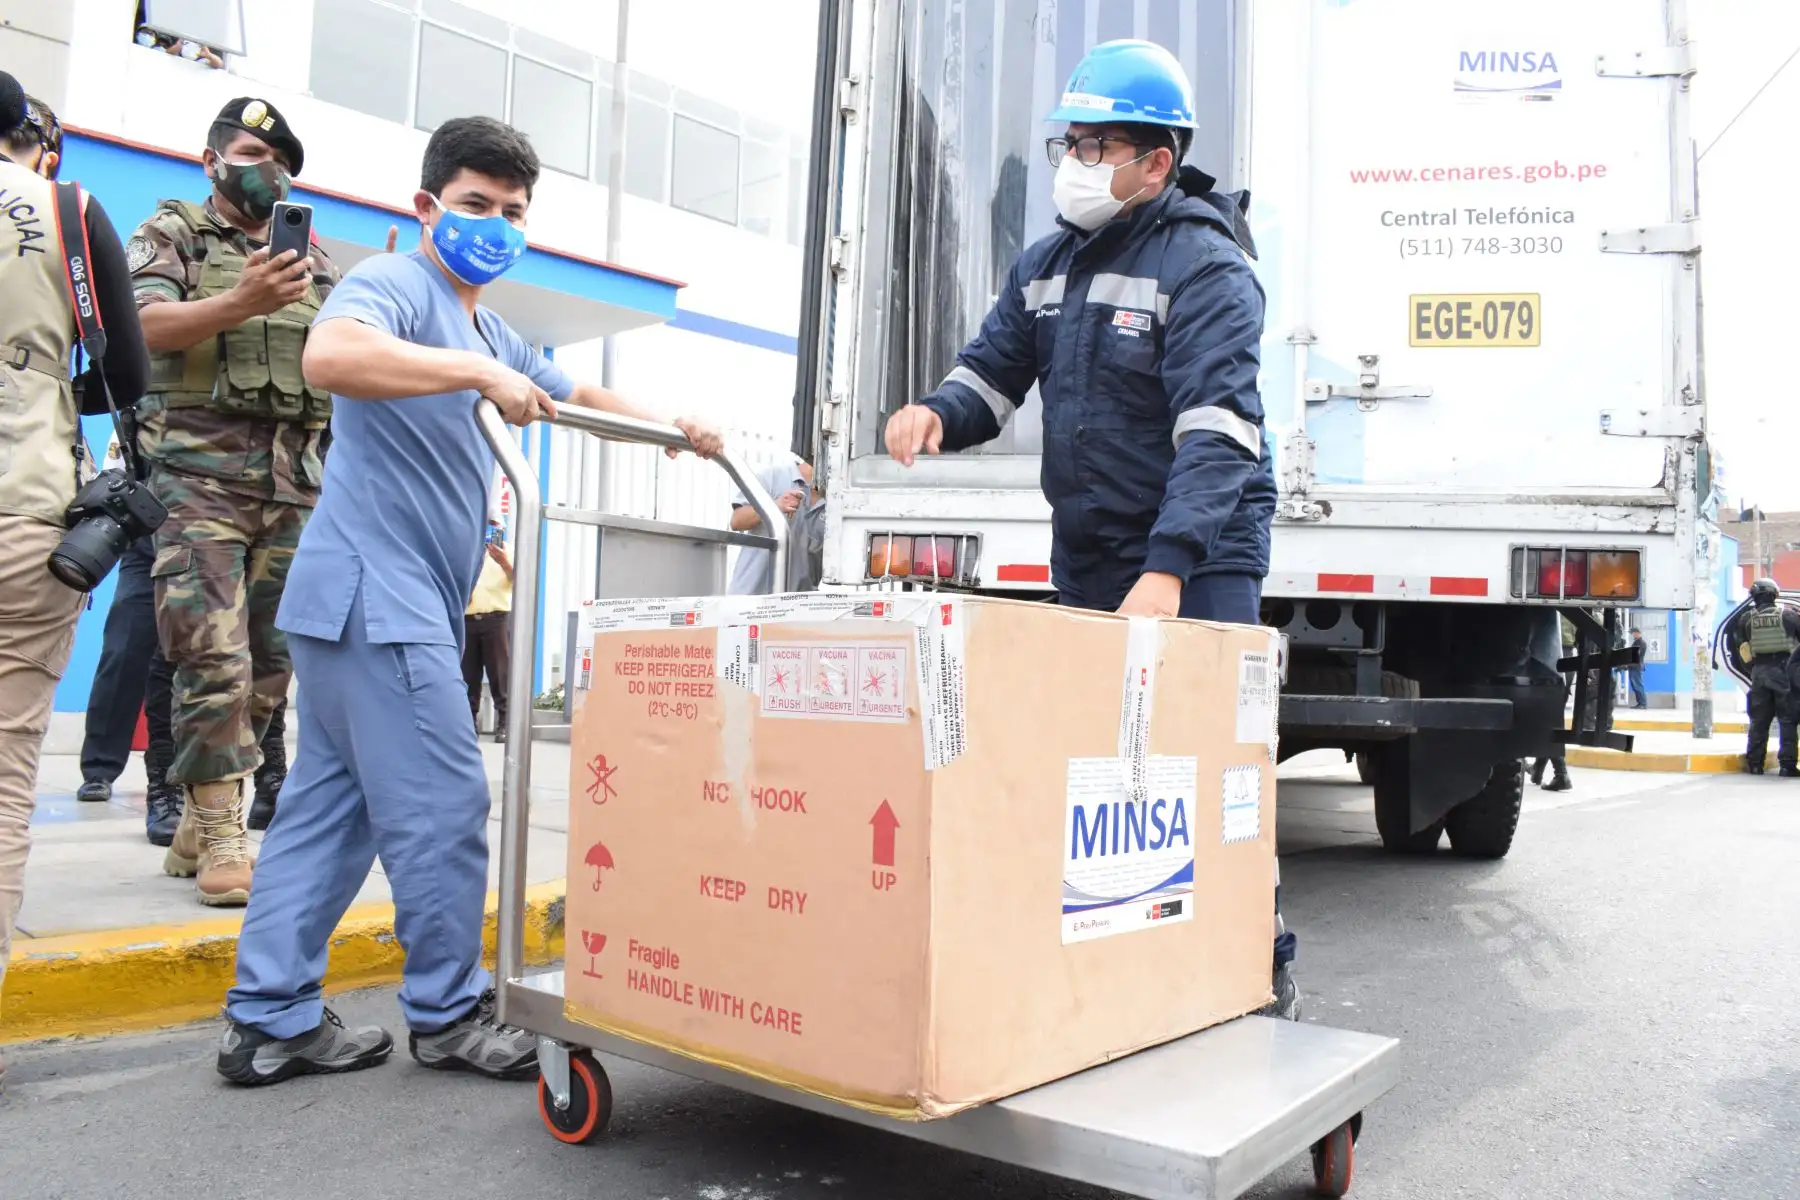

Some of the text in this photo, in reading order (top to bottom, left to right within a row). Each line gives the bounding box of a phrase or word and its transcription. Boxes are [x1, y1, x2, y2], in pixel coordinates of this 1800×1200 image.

[1459, 50, 1559, 73] MINSA
[1350, 160, 1607, 183] www.cenares.gob.pe
[1380, 206, 1575, 227] Central Telefónica
[1398, 236, 1563, 258] (511) 748-3030
[75, 282, 92, 318] EOS
[1415, 300, 1534, 340] EGE-079
[625, 643, 714, 659] Perishable Mate
[772, 650, 802, 660] VACCINE
[818, 650, 848, 660] VACUNA
[615, 661, 715, 678] KEEP REFRIGERA
[629, 680, 716, 698] DO NOT FREEZ
[778, 699, 801, 709] RUSH
[820, 700, 852, 711] URGENTE
[868, 703, 902, 714] URGENTE
[750, 786, 807, 814] HOOK
[1071, 797, 1189, 860] MINSA
[871, 871, 897, 891] UP
[700, 874, 808, 914] KEEP DRY
[628, 938, 680, 970] Fragile
[627, 969, 802, 1036] HANDLE WITH CARE
